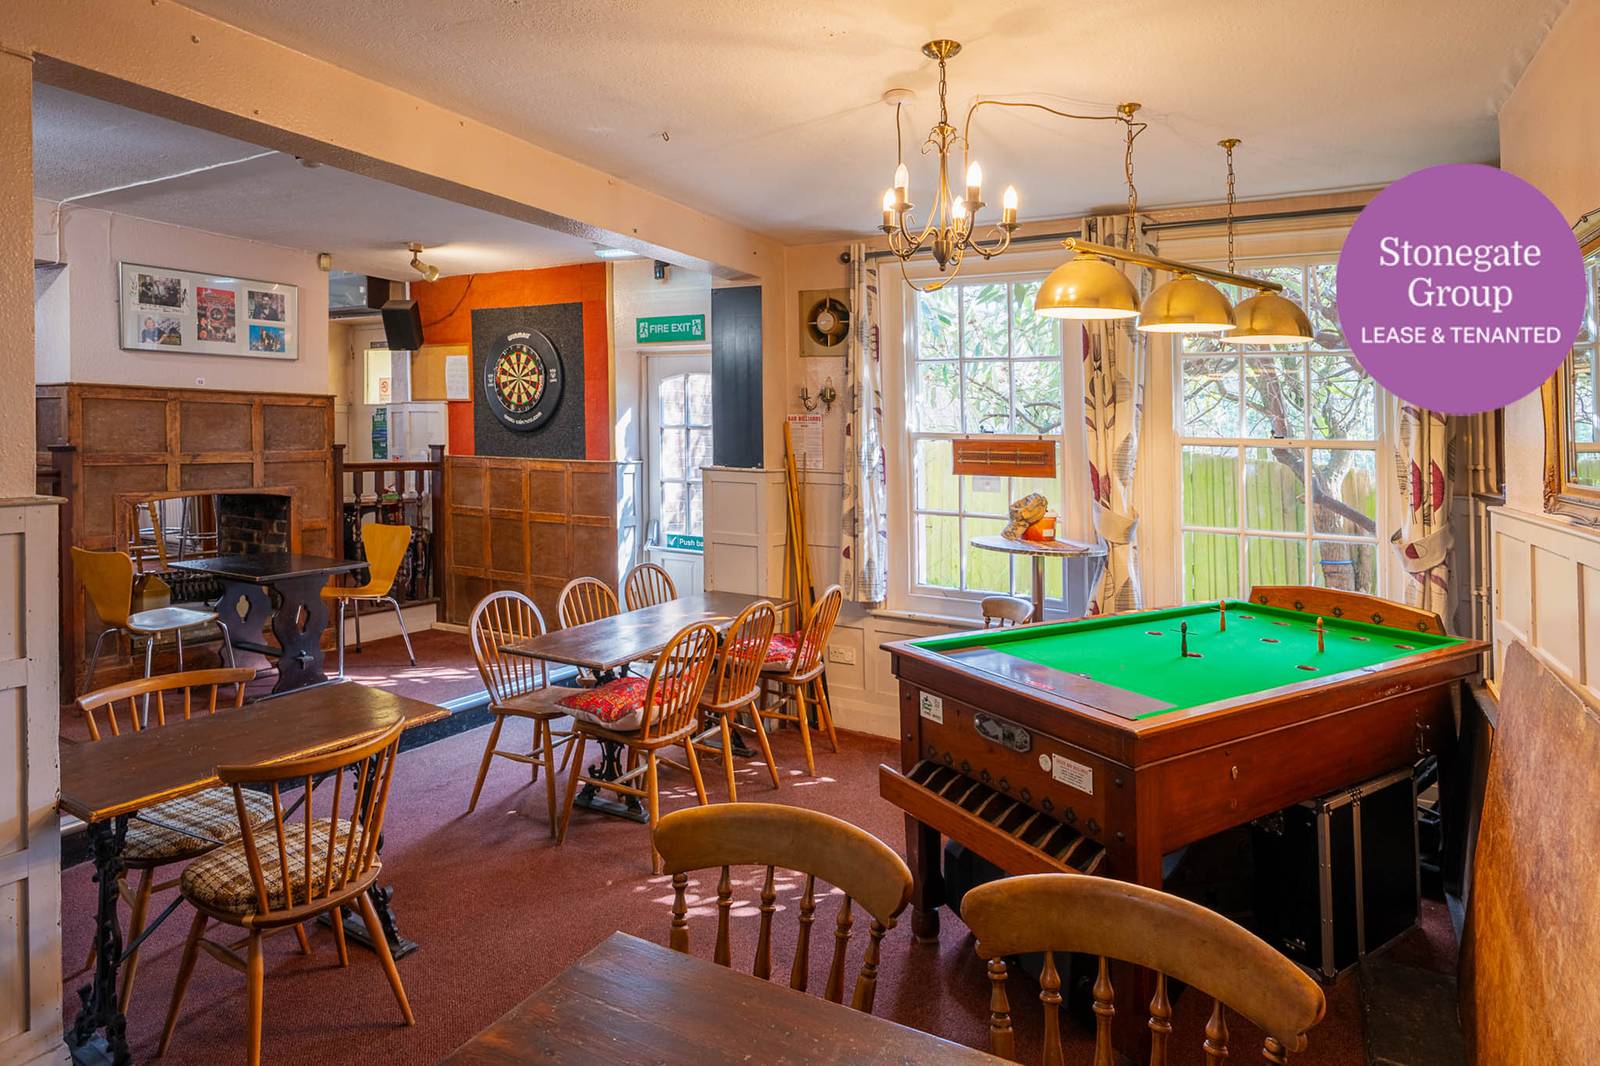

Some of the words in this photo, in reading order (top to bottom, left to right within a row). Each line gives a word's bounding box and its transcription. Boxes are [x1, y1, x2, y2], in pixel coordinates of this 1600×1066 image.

[649, 323, 669, 334] FIRE
[671, 322, 691, 333] EXIT
[679, 538, 695, 546] Push
[696, 539, 704, 547] ba
